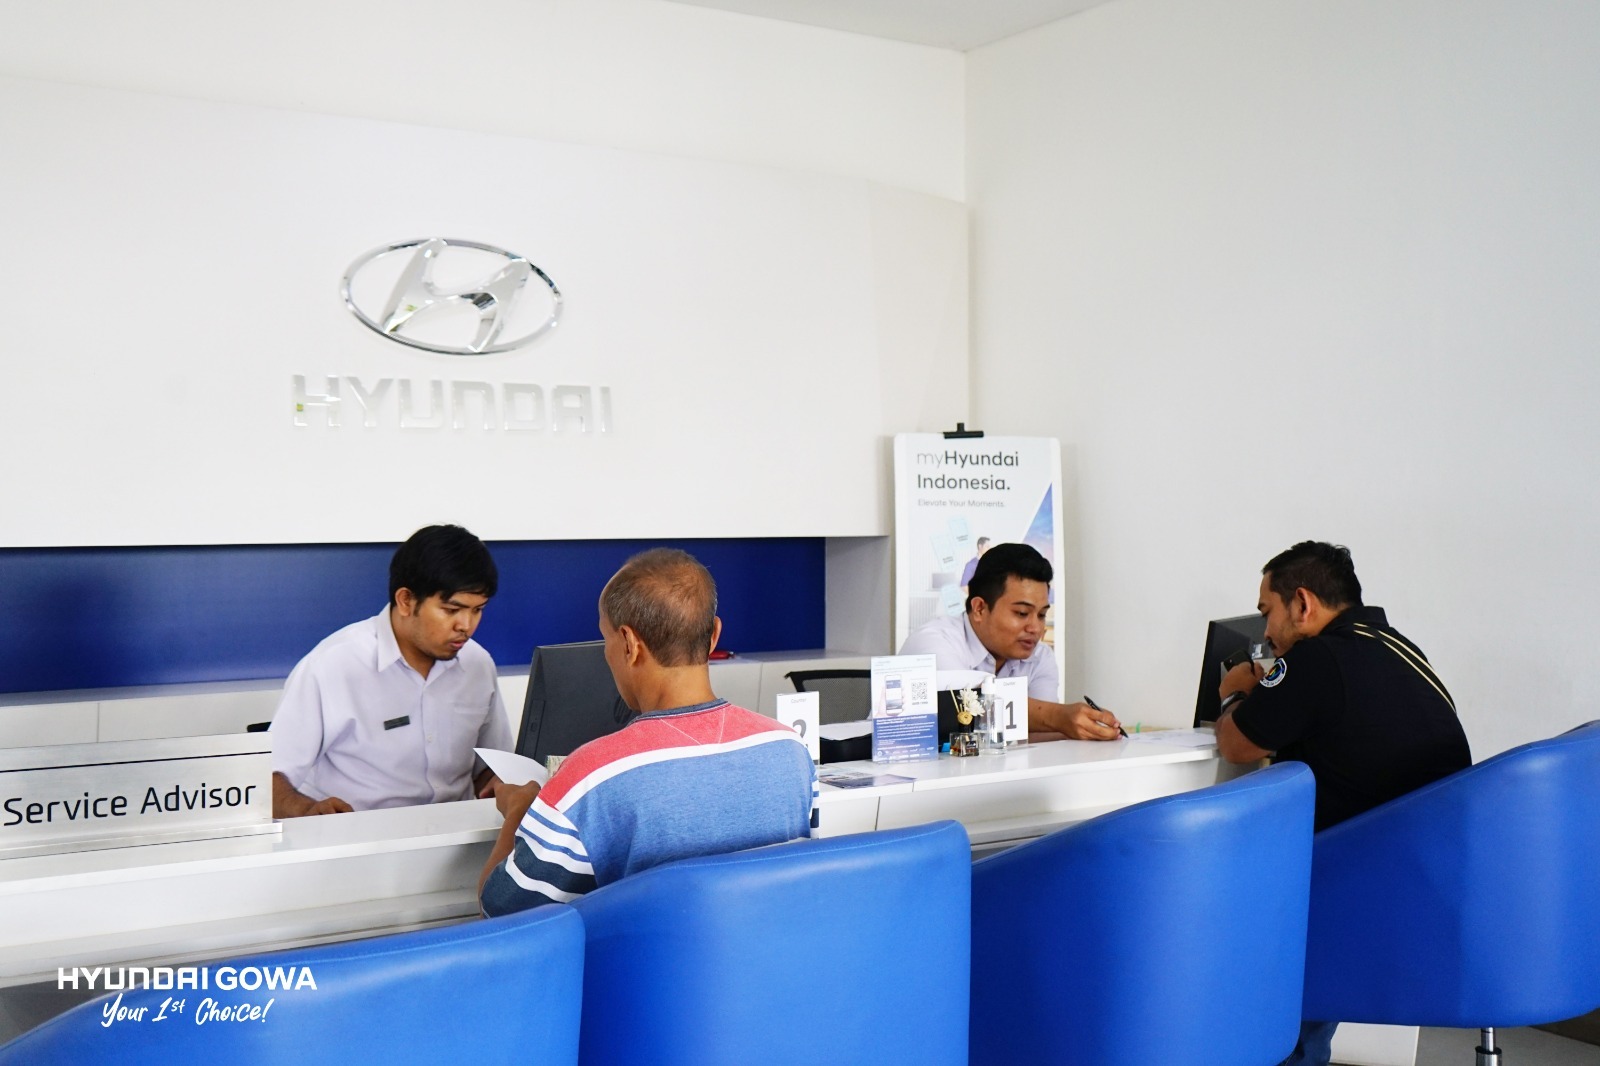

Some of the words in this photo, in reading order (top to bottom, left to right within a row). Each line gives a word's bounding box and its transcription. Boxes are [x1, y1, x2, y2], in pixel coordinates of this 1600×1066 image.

[291, 374, 613, 433] HYUNDAI
[917, 450, 1019, 469] myHyundai
[917, 474, 1011, 490] Indonesia.
[918, 499, 948, 507] Elevate
[949, 499, 967, 508] Your
[1005, 701, 1017, 730] 1
[3, 792, 128, 827] Service
[140, 782, 257, 814] Advisor
